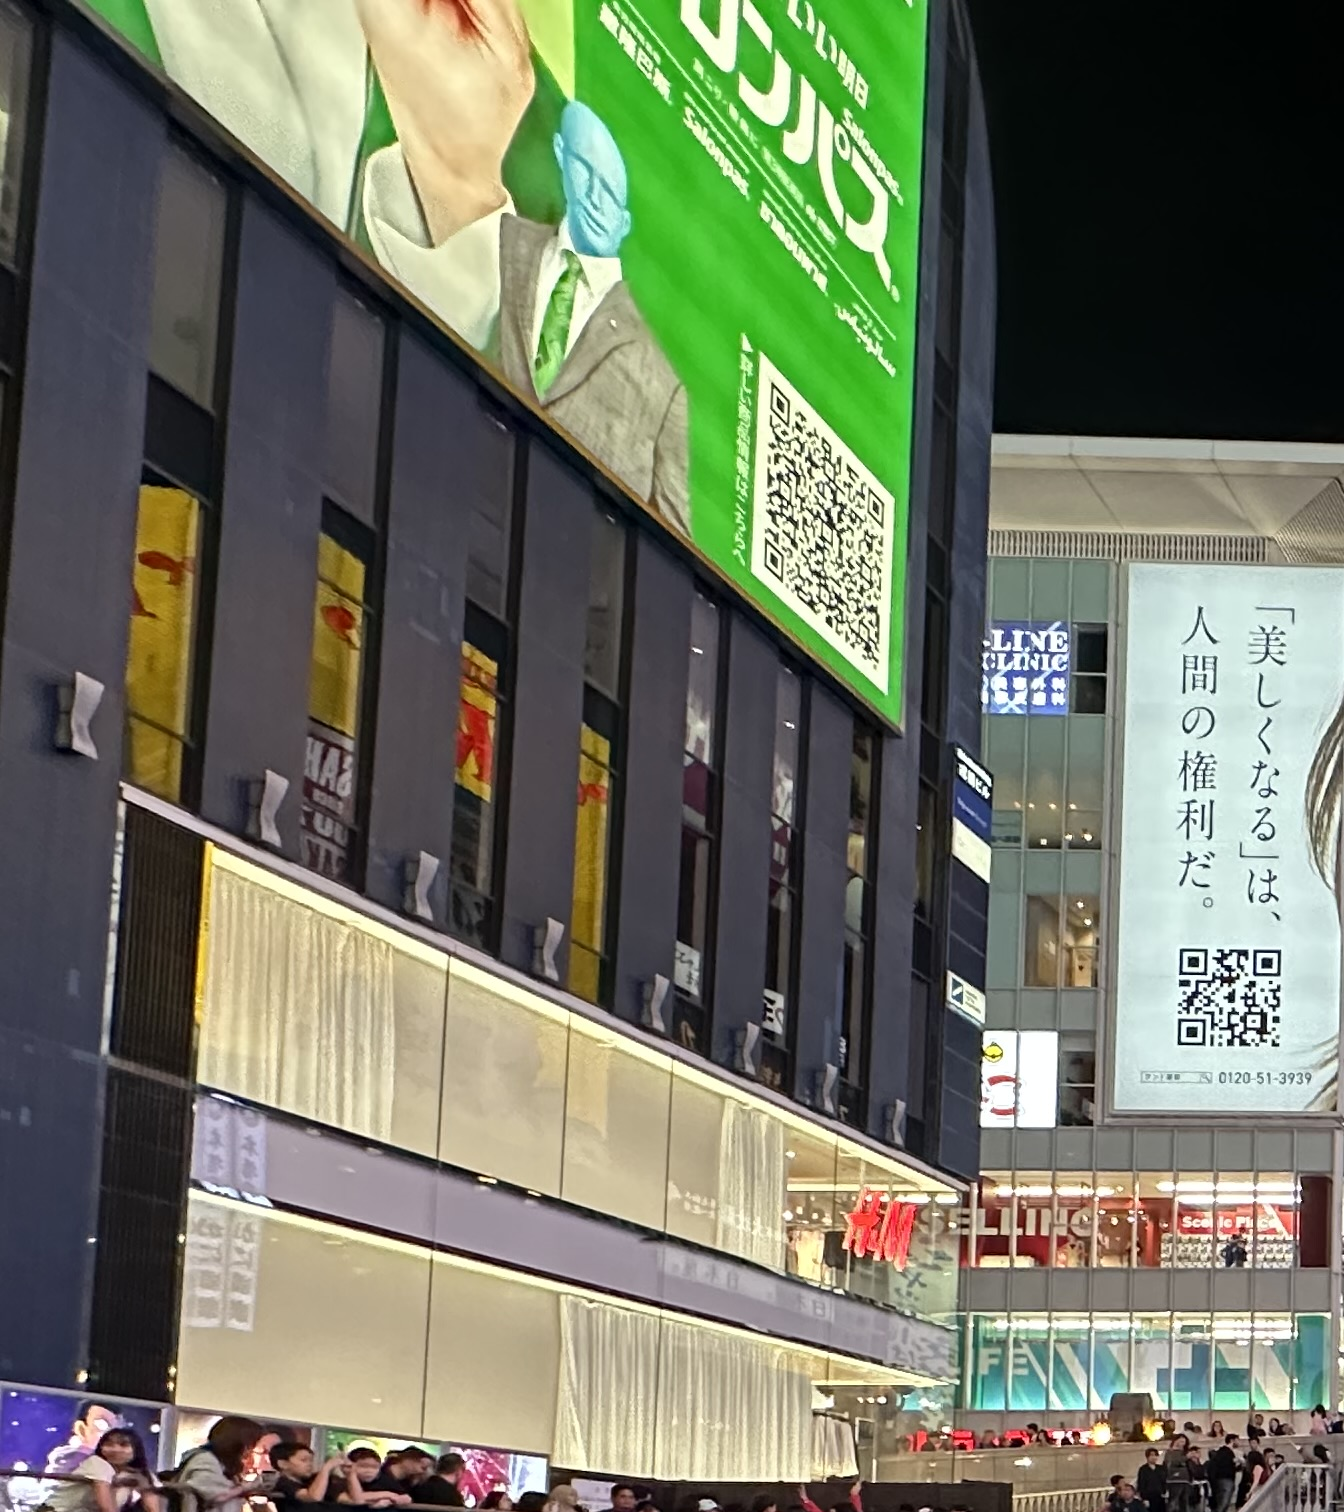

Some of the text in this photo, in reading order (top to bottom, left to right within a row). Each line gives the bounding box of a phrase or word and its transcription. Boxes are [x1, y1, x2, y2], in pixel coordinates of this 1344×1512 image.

[981, 652, 1069, 672] CLINIC
[1175, 605, 1220, 910] 人間の権利だ。
[1218, 1071, 1312, 1085] 0120-51-3939
